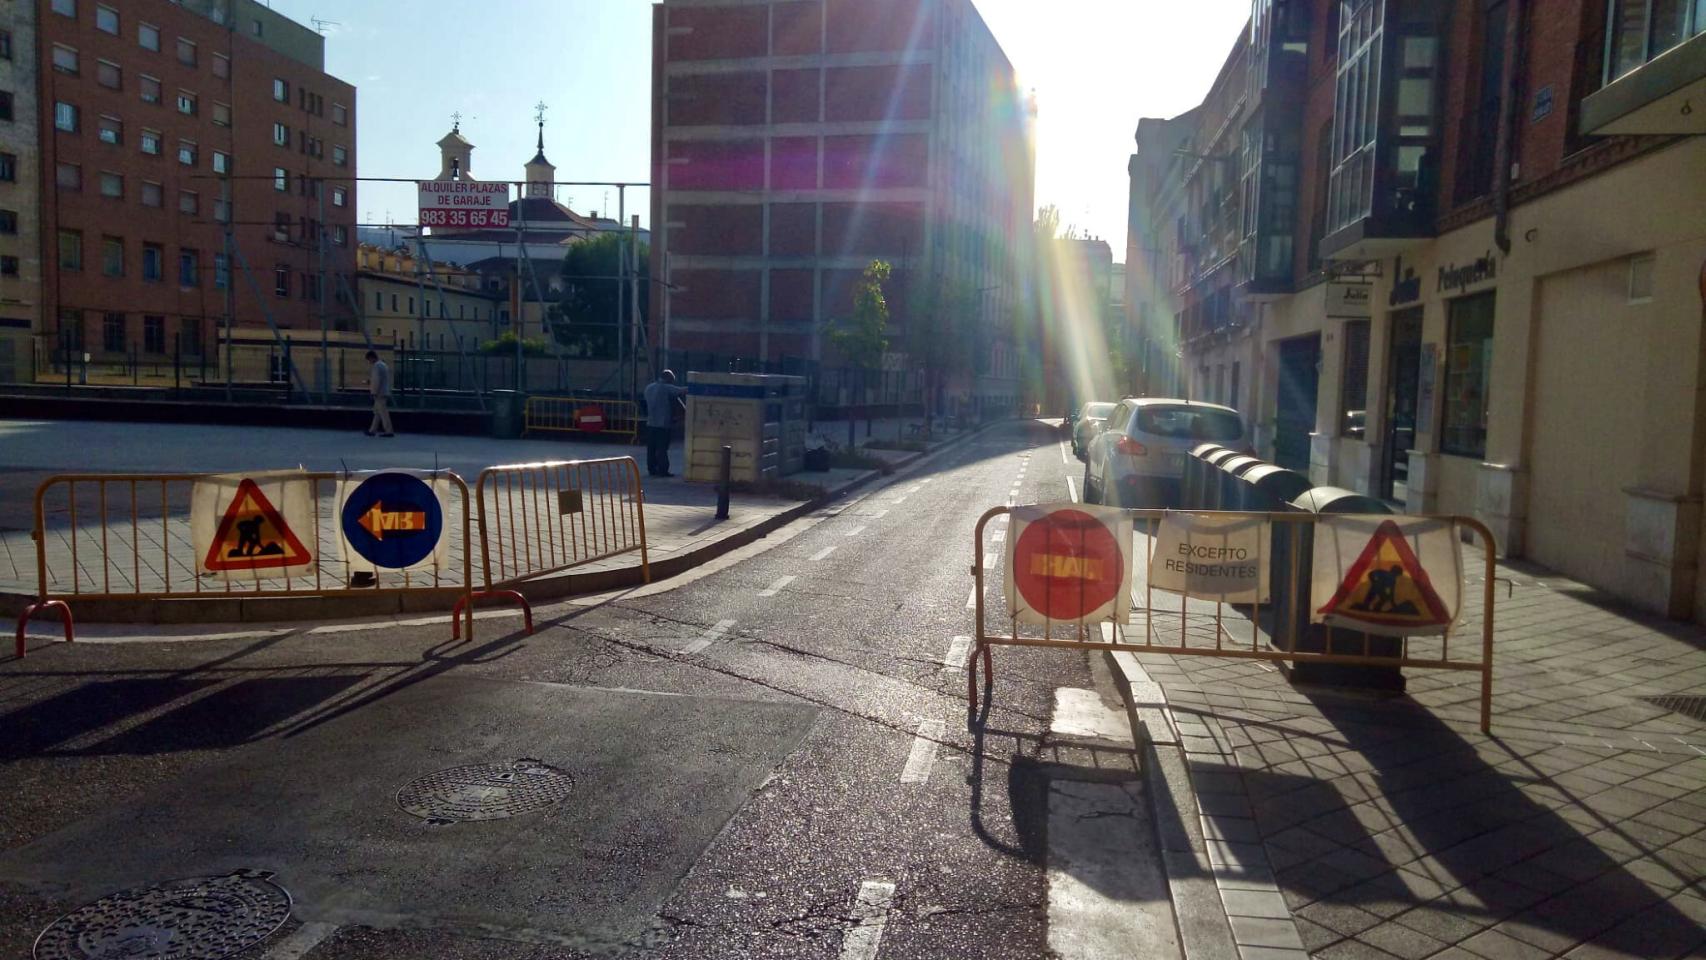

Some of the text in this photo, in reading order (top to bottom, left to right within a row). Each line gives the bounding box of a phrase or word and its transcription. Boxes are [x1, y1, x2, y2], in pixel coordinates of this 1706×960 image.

[421, 182, 507, 194] ALQUILER PLAZAS
[438, 195, 491, 206] DE GARAJE
[421, 210, 508, 226] 983 35 65 45
[1178, 543, 1247, 560] EXCEPTO
[1165, 558, 1257, 578] RESIDENTES
